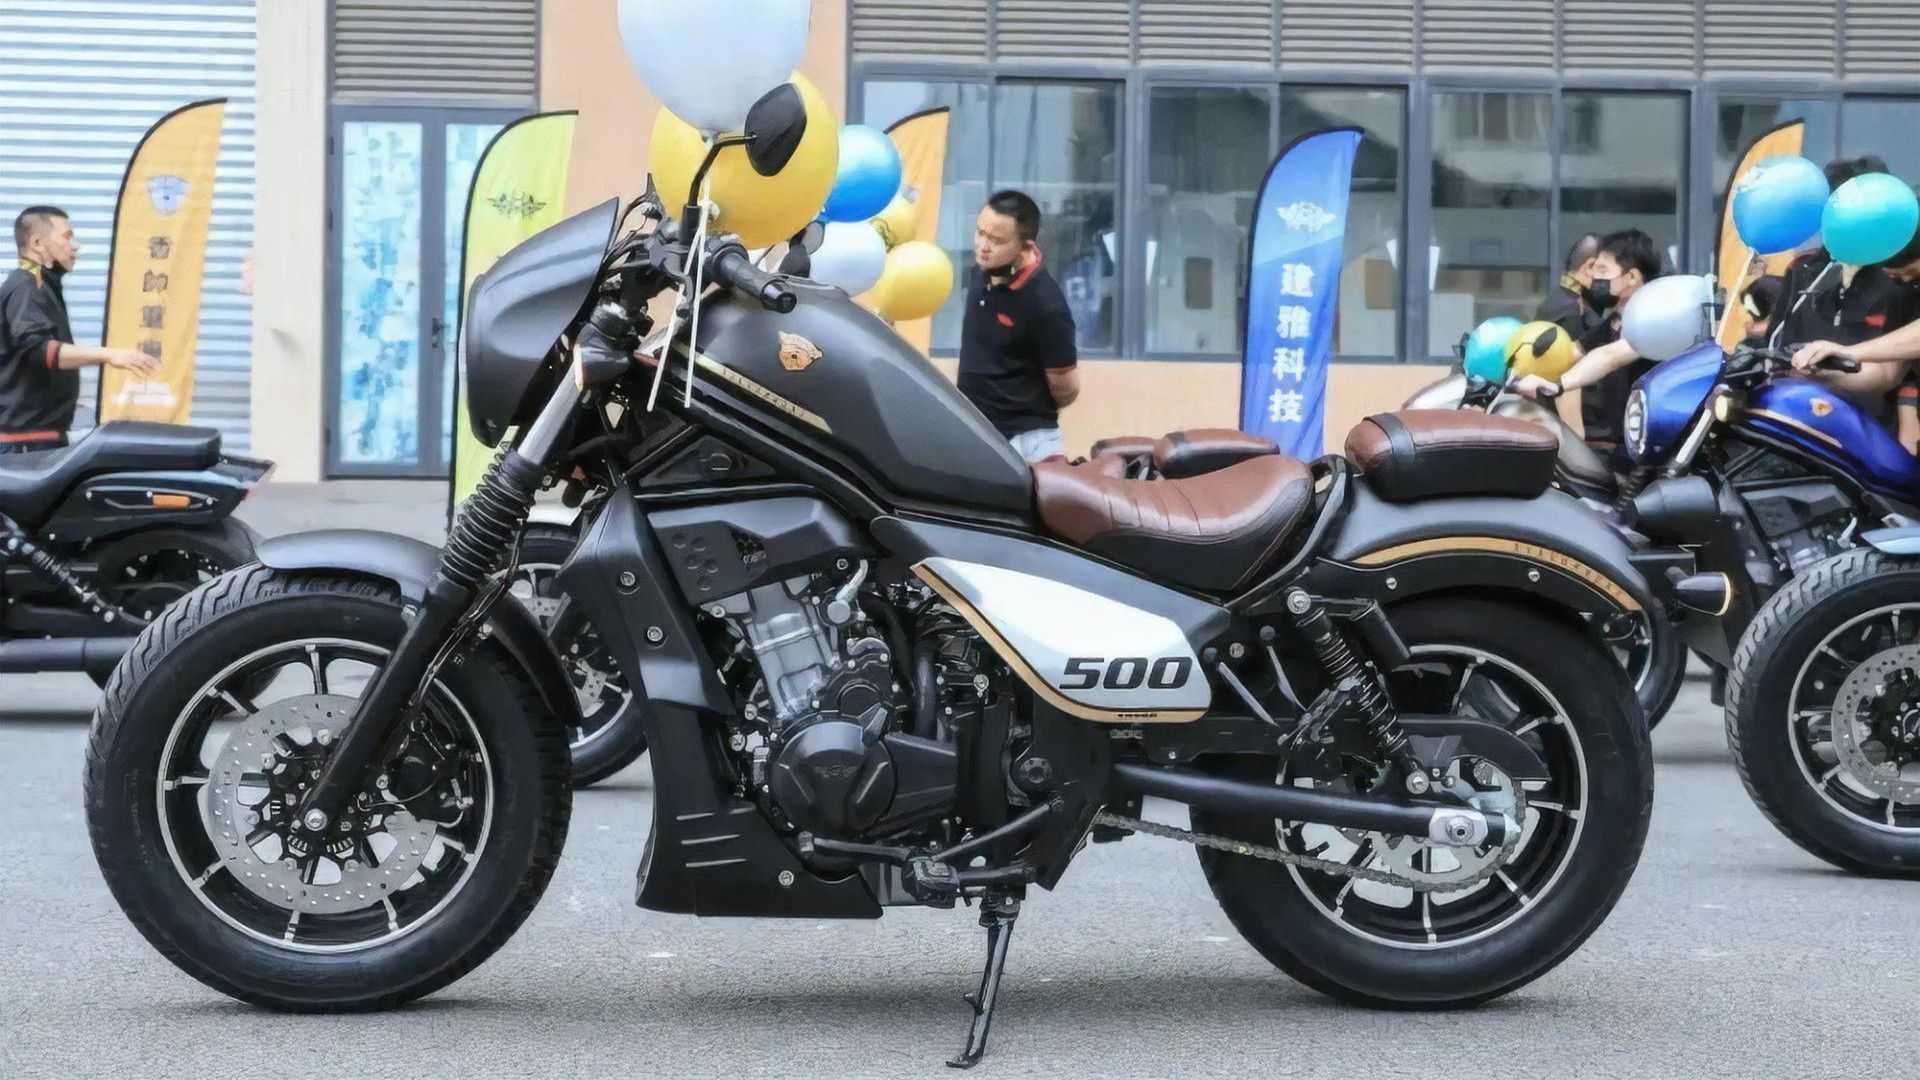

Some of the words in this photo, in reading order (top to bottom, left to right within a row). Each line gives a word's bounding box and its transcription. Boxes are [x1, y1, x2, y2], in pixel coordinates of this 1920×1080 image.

[1269, 262, 1314, 423] 建雅科技
[1059, 657, 1193, 689] 500
